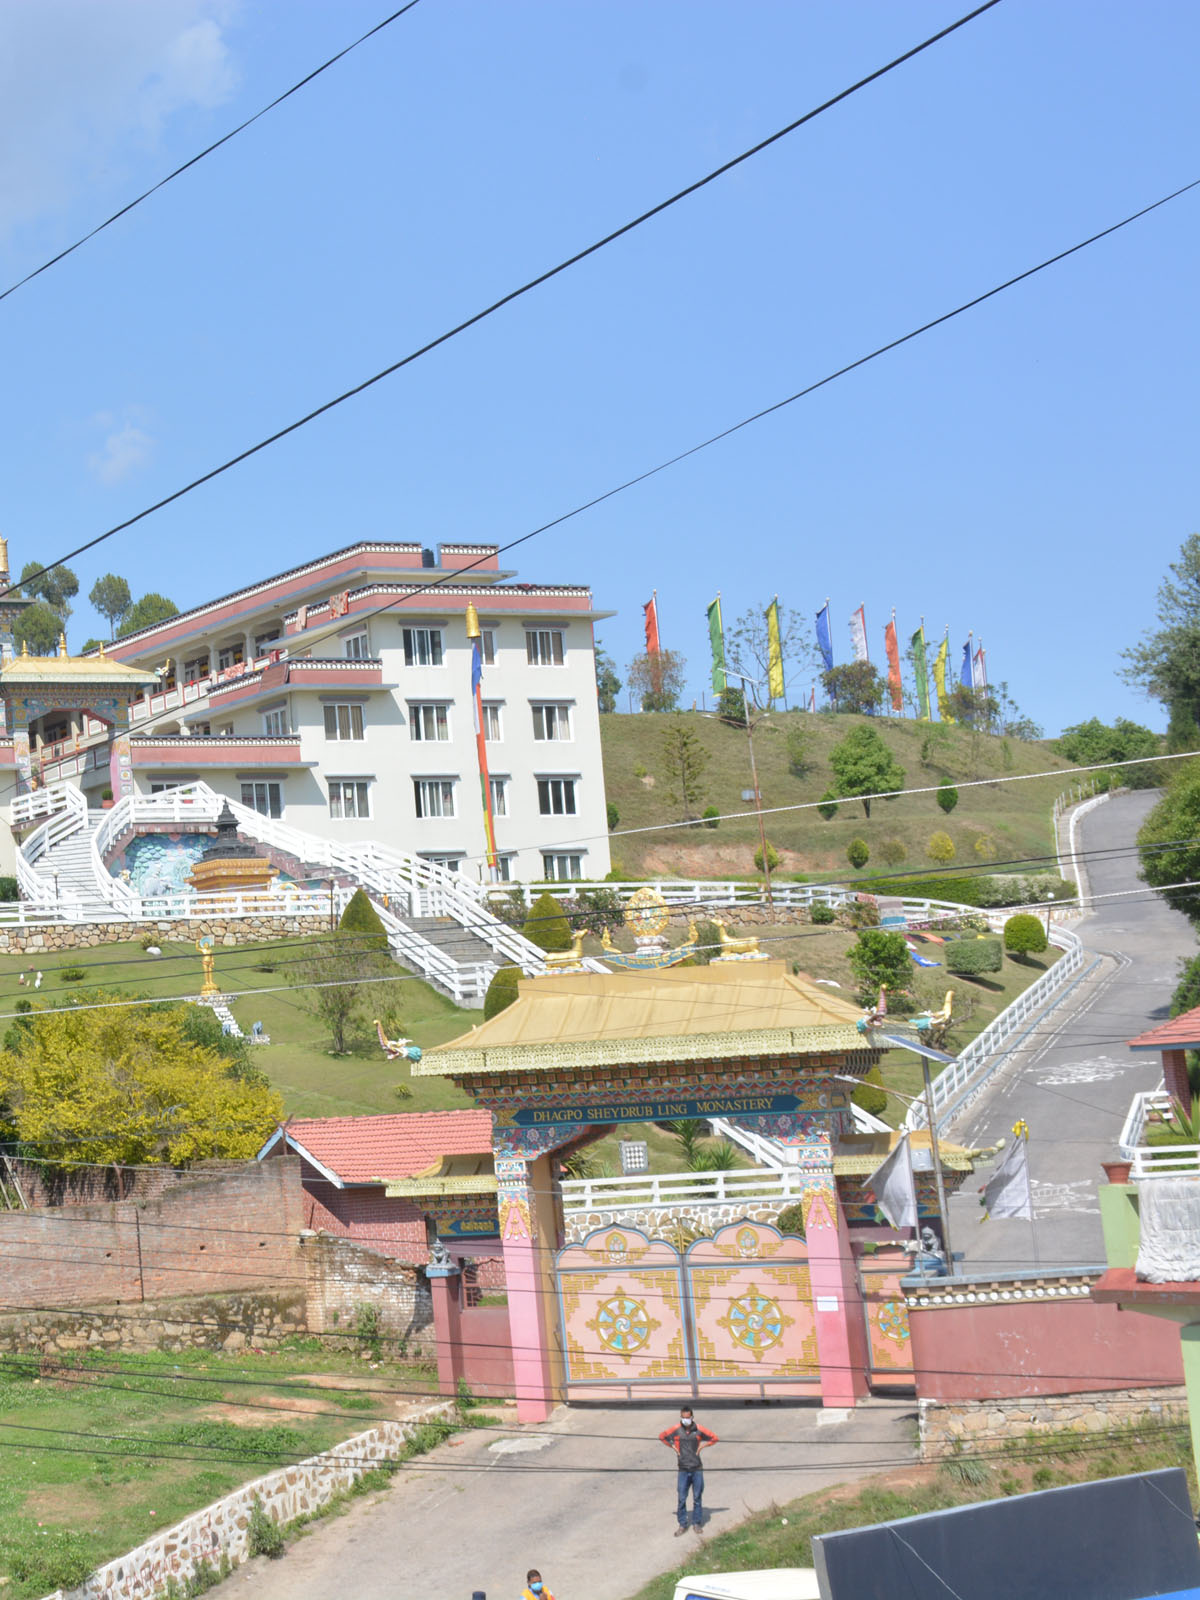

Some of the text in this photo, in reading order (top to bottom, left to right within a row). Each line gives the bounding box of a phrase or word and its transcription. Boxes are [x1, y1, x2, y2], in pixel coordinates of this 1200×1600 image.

[533, 1097, 774, 1122] DHAGPO SHEYDRUB LING MONASTERY
